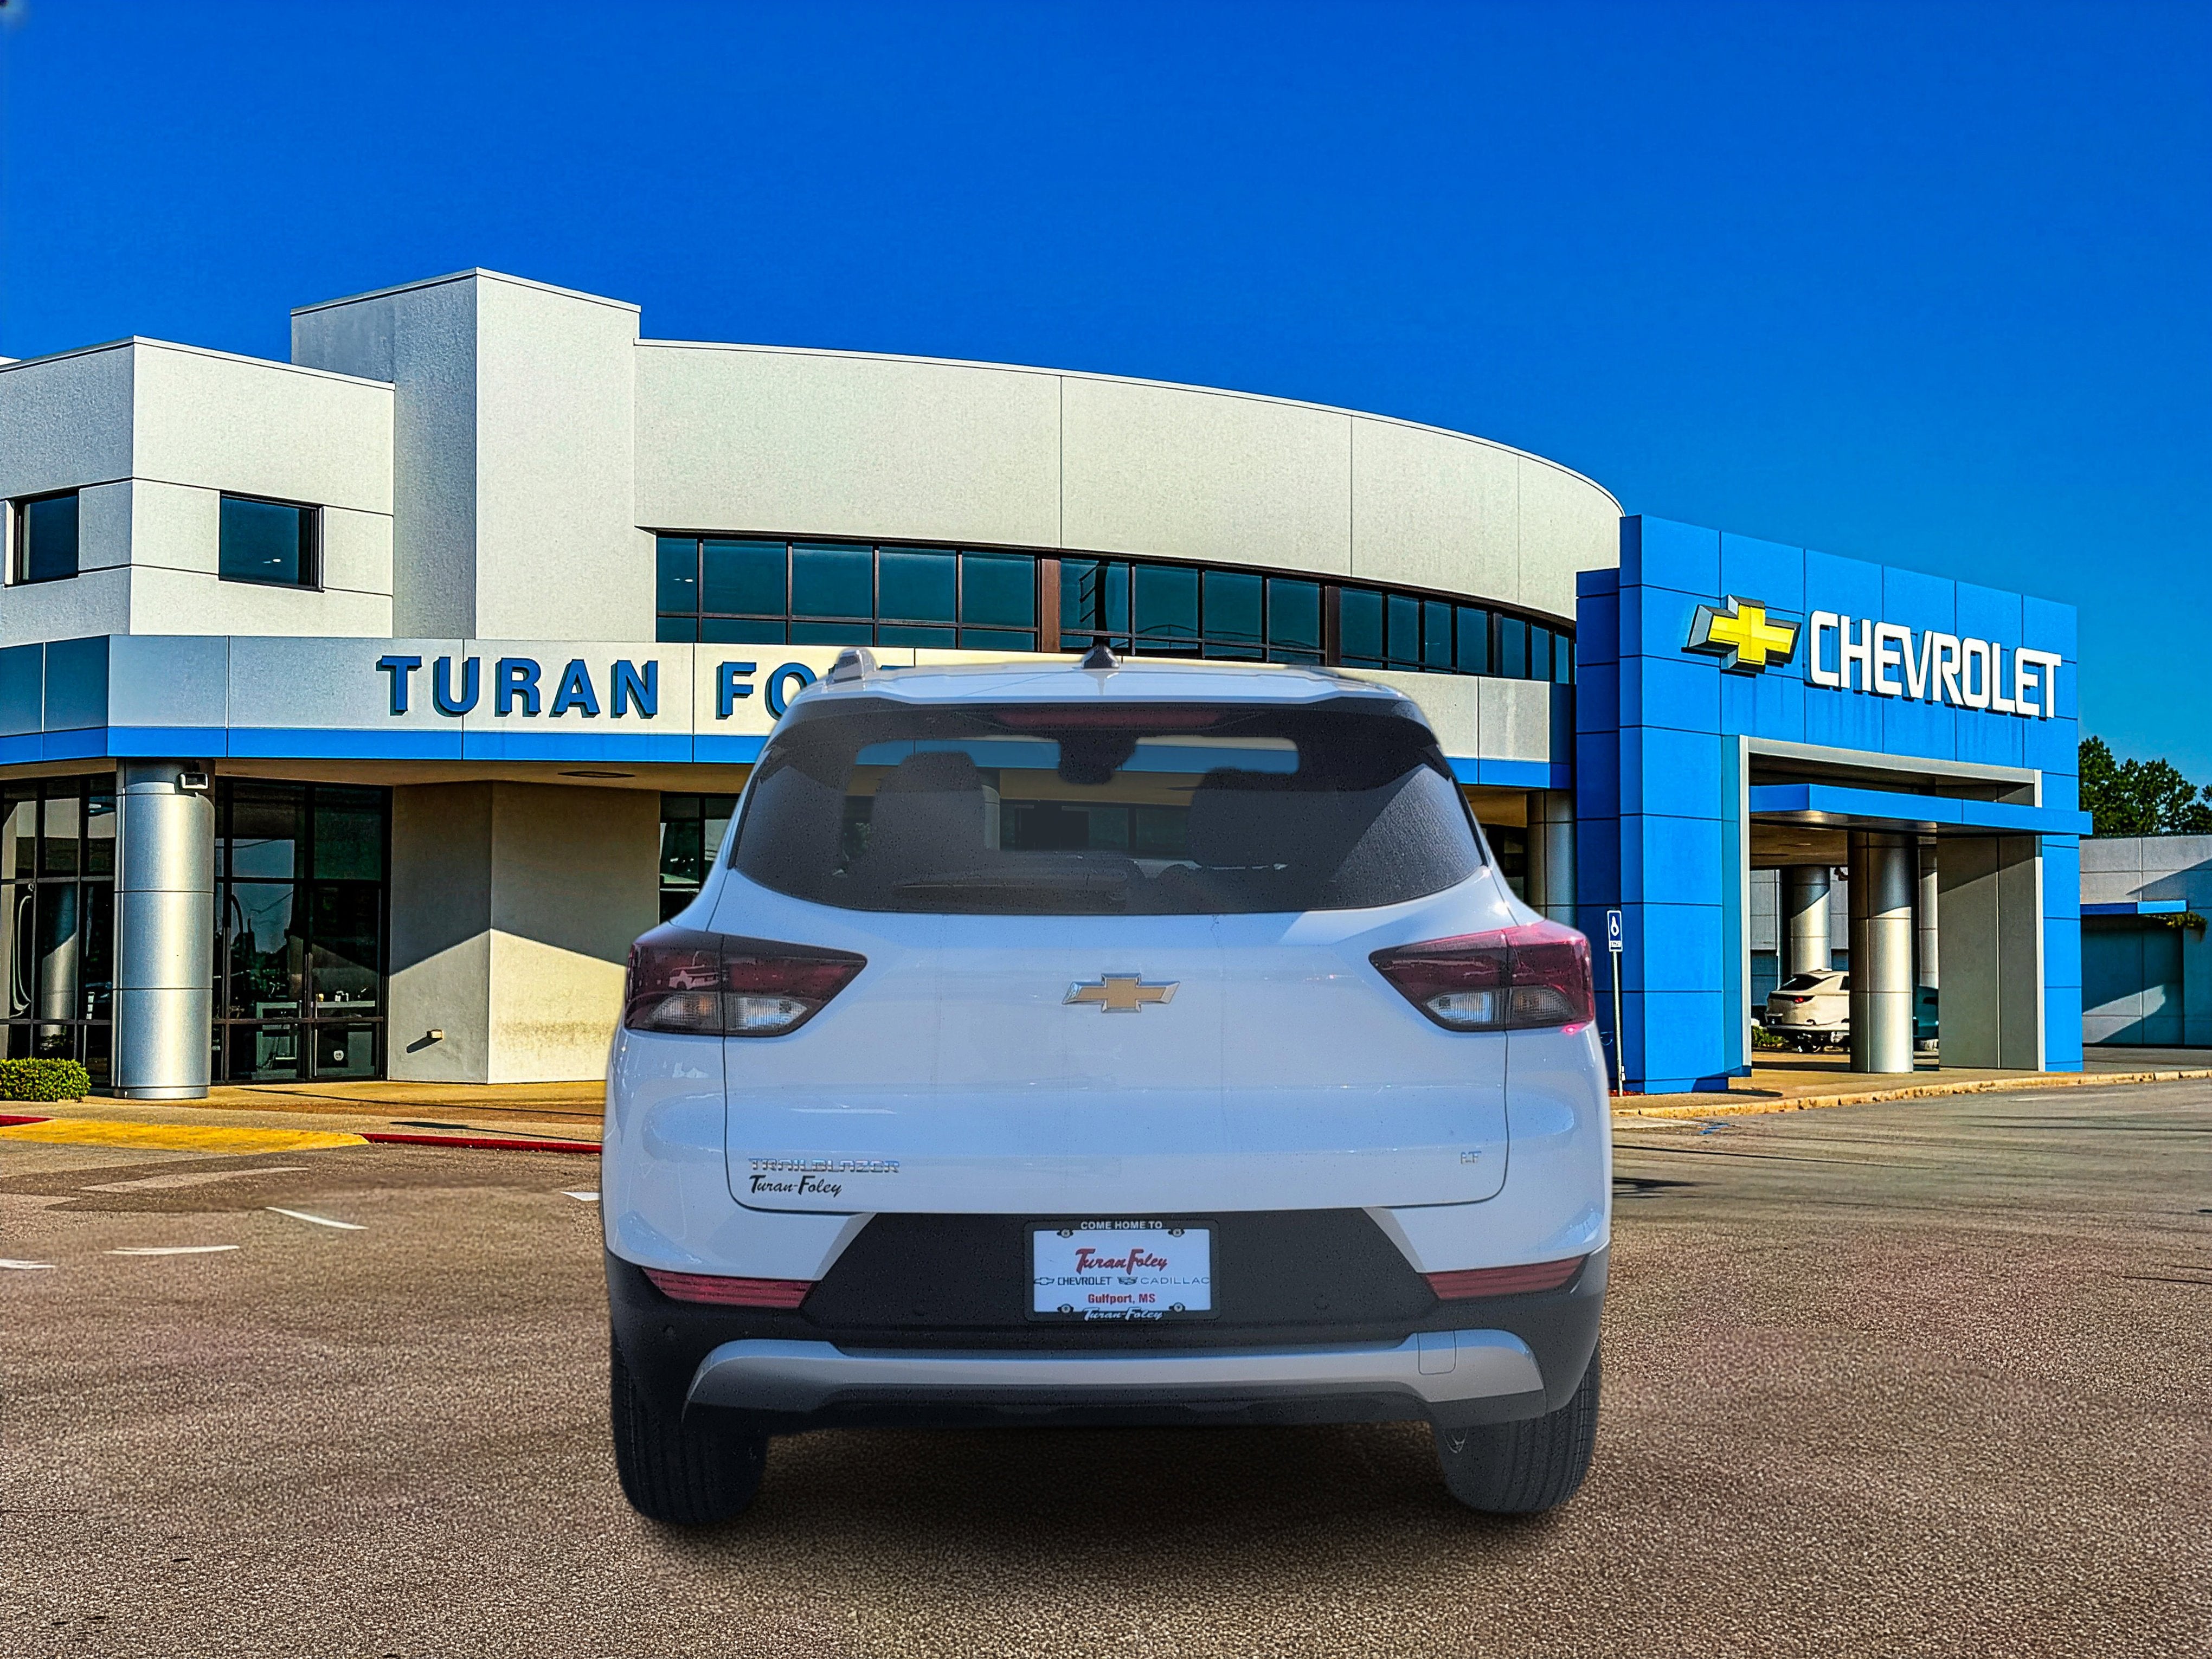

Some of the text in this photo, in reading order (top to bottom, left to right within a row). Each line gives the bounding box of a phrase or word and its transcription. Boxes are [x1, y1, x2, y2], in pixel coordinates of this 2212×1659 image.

[1810, 610, 2062, 718] CHEVROLET
[376, 654, 659, 719] TURAN
[748, 1158, 899, 1173] TRAILBLAZER
[1081, 1220, 1163, 1230] COME HOME TO
[1058, 1277, 1210, 1285] CHEVROLET CADILLAC
[1088, 1293, 1155, 1304] Gulfport, MS
